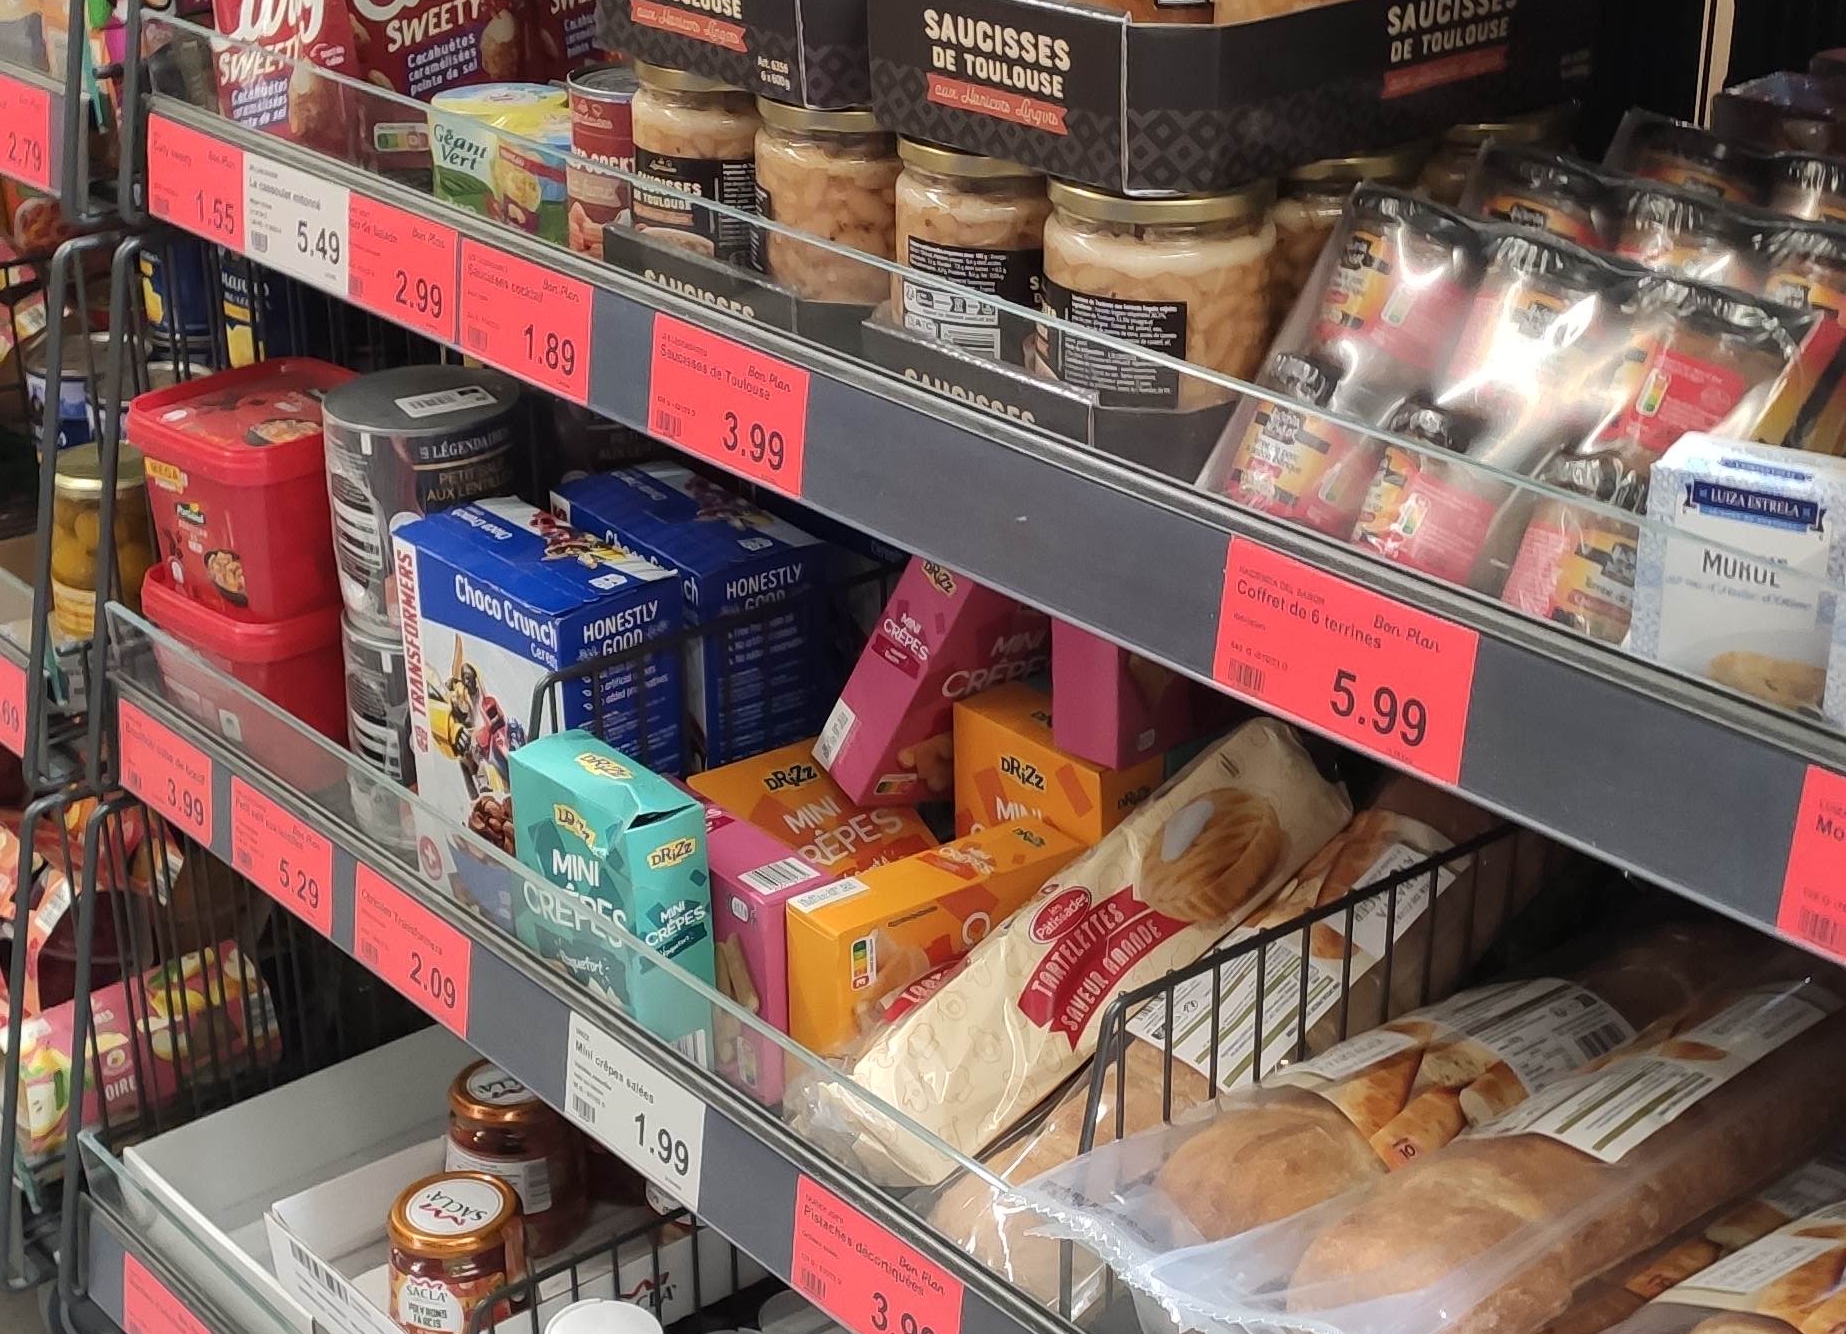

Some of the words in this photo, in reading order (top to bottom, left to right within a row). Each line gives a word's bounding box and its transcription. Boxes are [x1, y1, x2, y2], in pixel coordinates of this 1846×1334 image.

[407, 32, 476, 69] Cacahuètes
[923, 7, 1071, 72] SAUCISSES
[1390, 39, 1413, 64] DE
[1421, 16, 1511, 56] TOULOUSE
[407, 49, 477, 83] caramélisées
[446, 66, 460, 82] de
[931, 44, 957, 72] DE
[963, 52, 1064, 100] TOULOUSE
[7, 130, 42, 172] 2.79
[433, 123, 489, 160] Géant
[440, 143, 479, 172] Vert
[196, 188, 235, 236] 1.55
[296, 219, 340, 265] 5.49
[395, 269, 443, 319] 2.99
[521, 323, 576, 376] 1.89
[660, 343, 708, 375] Saucisses
[709, 366, 723, 381] de
[725, 370, 771, 401] Toulouse
[748, 364, 766, 383] Bon
[769, 371, 791, 393] Plan
[722, 411, 785, 471] 3.99
[426, 488, 456, 503] AUX
[1748, 495, 1800, 518] ESTRELA
[725, 562, 803, 601] HONESTLY
[396, 548, 429, 717] TRANSFORMERS
[454, 573, 502, 621] Choco
[503, 595, 558, 653] Crunch
[583, 599, 659, 645] HONESTLY
[900, 611, 923, 635] MINI
[1237, 579, 1287, 612] Coffret
[1289, 601, 1307, 620] de
[1310, 609, 1320, 625] 6
[1324, 616, 1382, 650] terrines
[1373, 613, 1402, 638] Bon
[1406, 627, 1441, 654] Plan
[882, 617, 930, 662] CRÊPES
[1329, 667, 1427, 747] 5.99
[166, 777, 205, 827] 3.99
[782, 795, 842, 835] MINI
[797, 807, 903, 867] RÊPES
[1815, 813, 1846, 842] Mo
[278, 857, 320, 910] 5.29
[552, 848, 600, 888] MINI
[645, 907, 706, 948] CRÊPES
[659, 900, 686, 924] MINI
[1030, 902, 1125, 997] TARTELETTES
[409, 951, 457, 1009] 2.09
[1060, 970, 1110, 1032] SAVEUR
[1102, 918, 1163, 976] AMANDE
[104, 1076, 138, 1102] OIRE
[575, 1040, 594, 1061] Mini
[595, 1055, 624, 1084] crêpes
[626, 1077, 655, 1105] salées
[634, 1112, 690, 1177] 1.99
[803, 1204, 854, 1248] Pistaches
[899, 1255, 919, 1277] Bon
